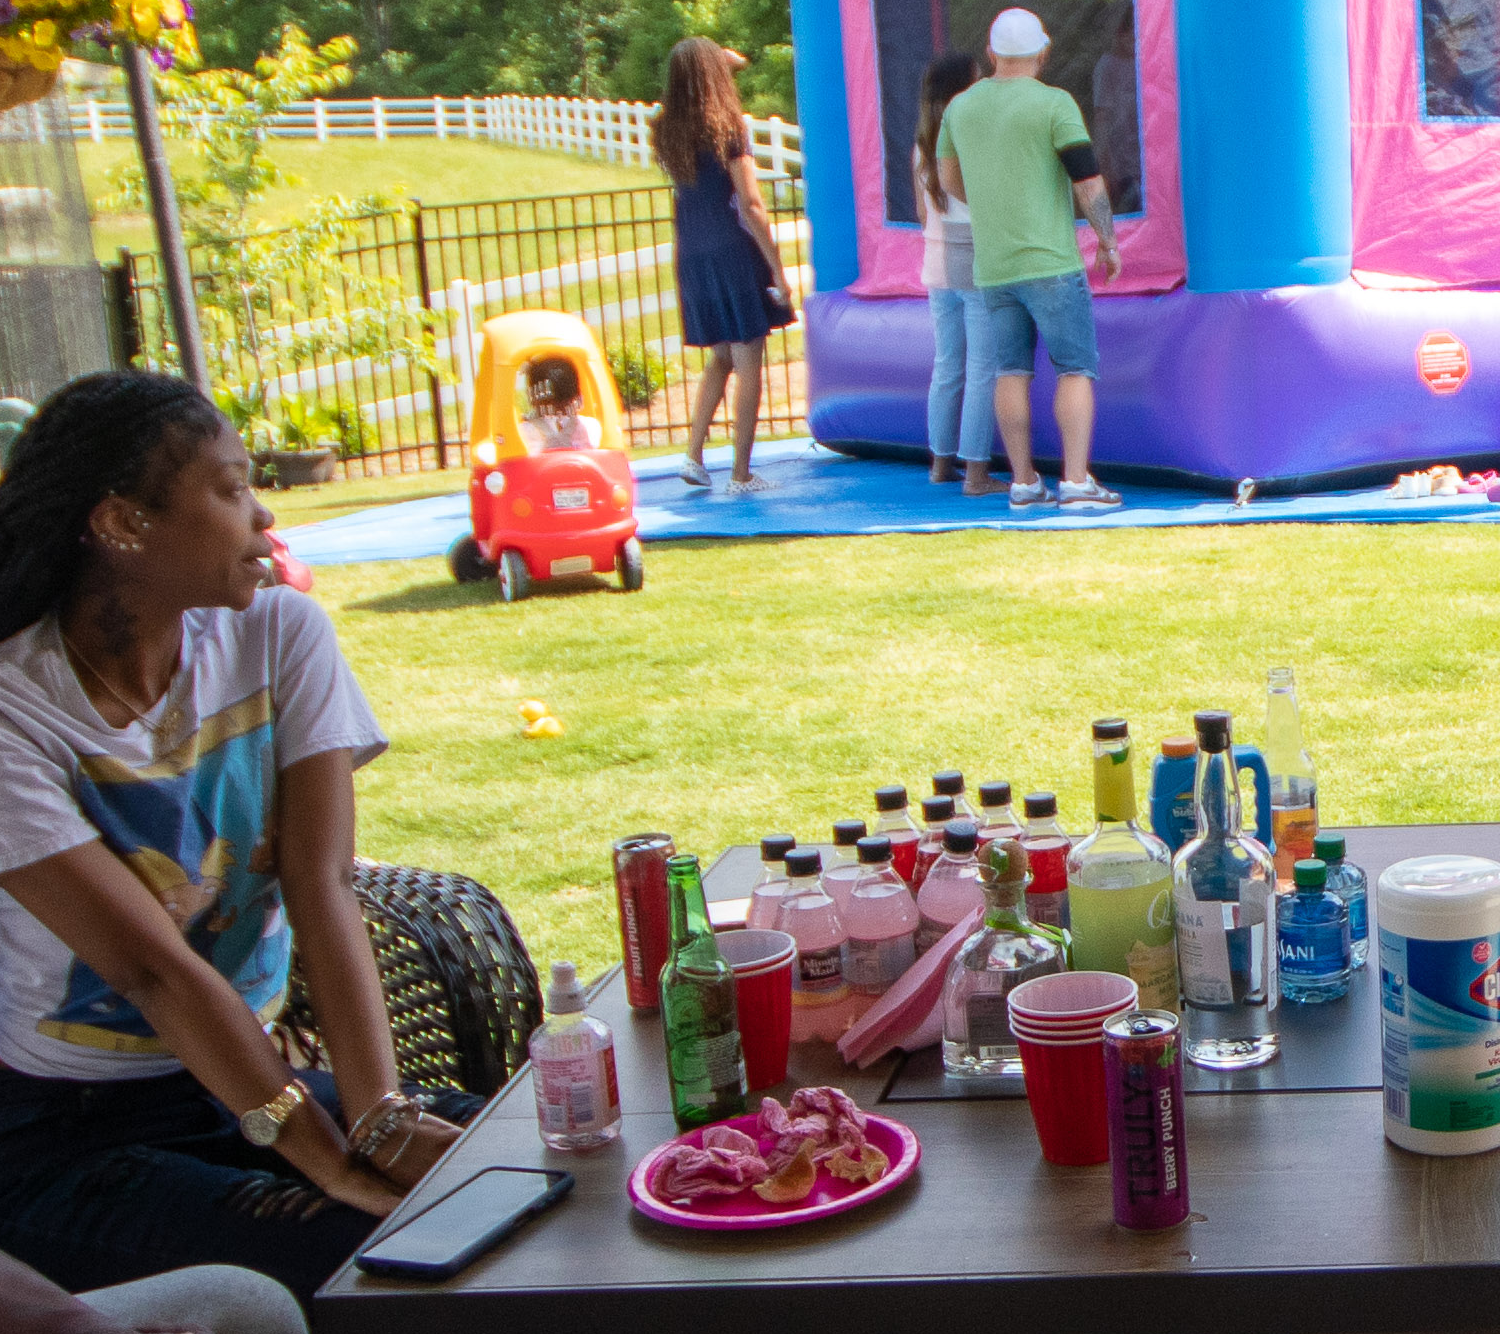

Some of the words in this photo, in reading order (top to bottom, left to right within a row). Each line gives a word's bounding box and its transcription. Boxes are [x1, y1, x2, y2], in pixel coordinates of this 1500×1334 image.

[624, 898, 638, 942] PUNCH
[630, 945, 643, 977] FRUIT
[1159, 1087, 1174, 1141] PUNCH
[1123, 1080, 1160, 1205] TRULY
[1163, 1146, 1178, 1191] BERRY
